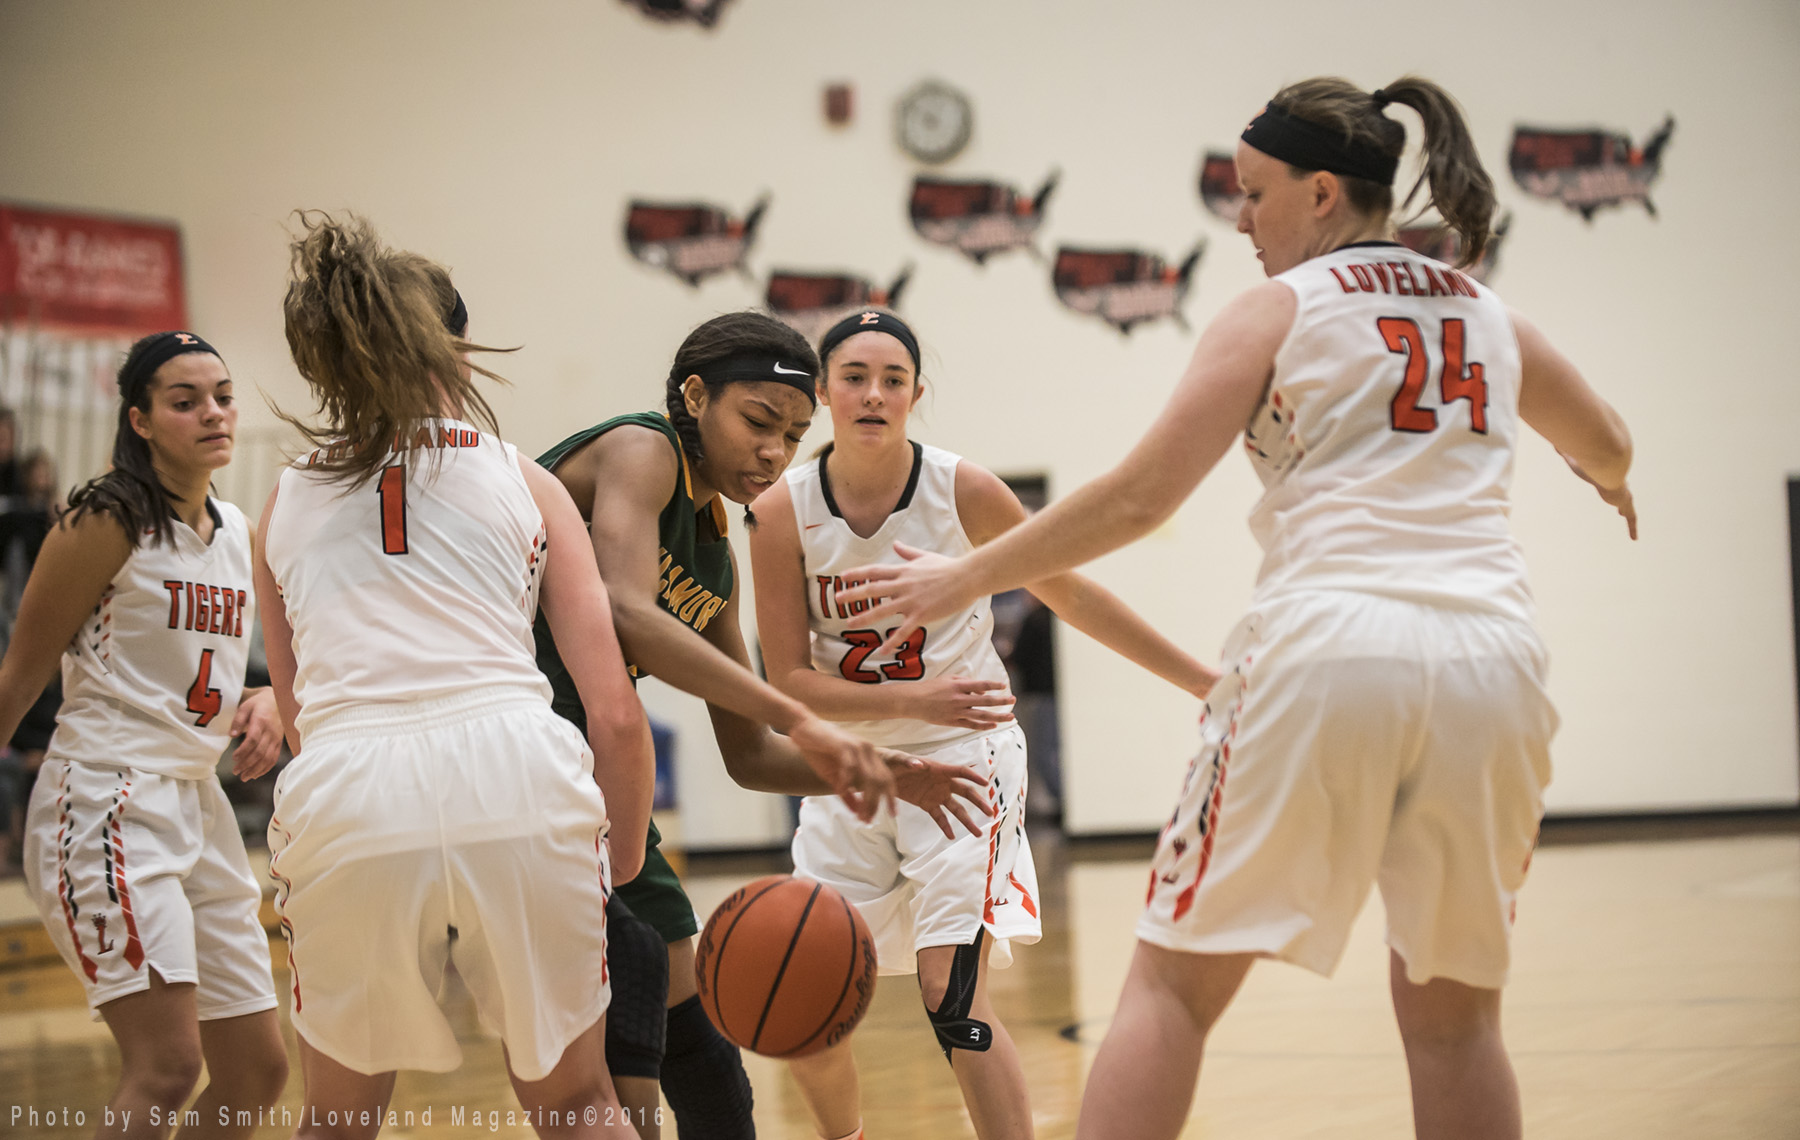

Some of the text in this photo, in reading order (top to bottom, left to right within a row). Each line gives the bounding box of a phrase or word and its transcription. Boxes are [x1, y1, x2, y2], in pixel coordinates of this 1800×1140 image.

[1329, 261, 1479, 299] LOVELAND
[1377, 316, 1489, 436] 24
[376, 464, 409, 555] 1
[163, 579, 247, 638] TIGERS
[839, 626, 928, 684] 23
[186, 648, 223, 728] 4
[969, 1027, 981, 1042] KT
